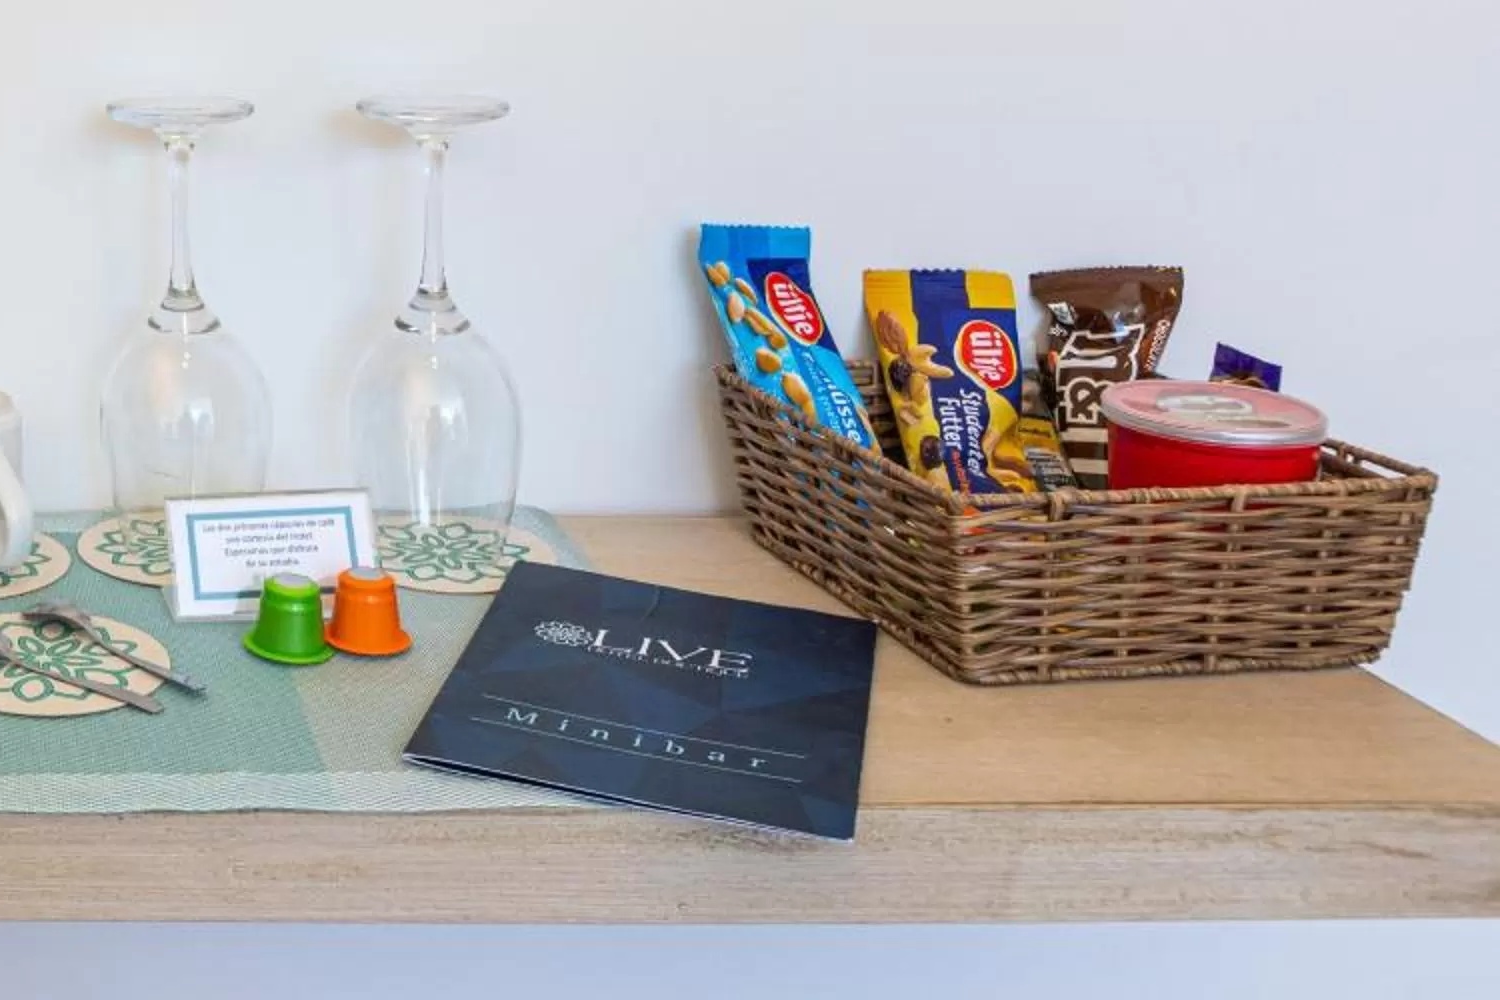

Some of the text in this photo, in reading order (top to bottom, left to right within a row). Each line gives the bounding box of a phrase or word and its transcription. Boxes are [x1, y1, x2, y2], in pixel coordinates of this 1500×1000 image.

[968, 330, 1006, 381] ültje
[937, 396, 963, 451] Futter
[506, 707, 767, 768] Minibar
